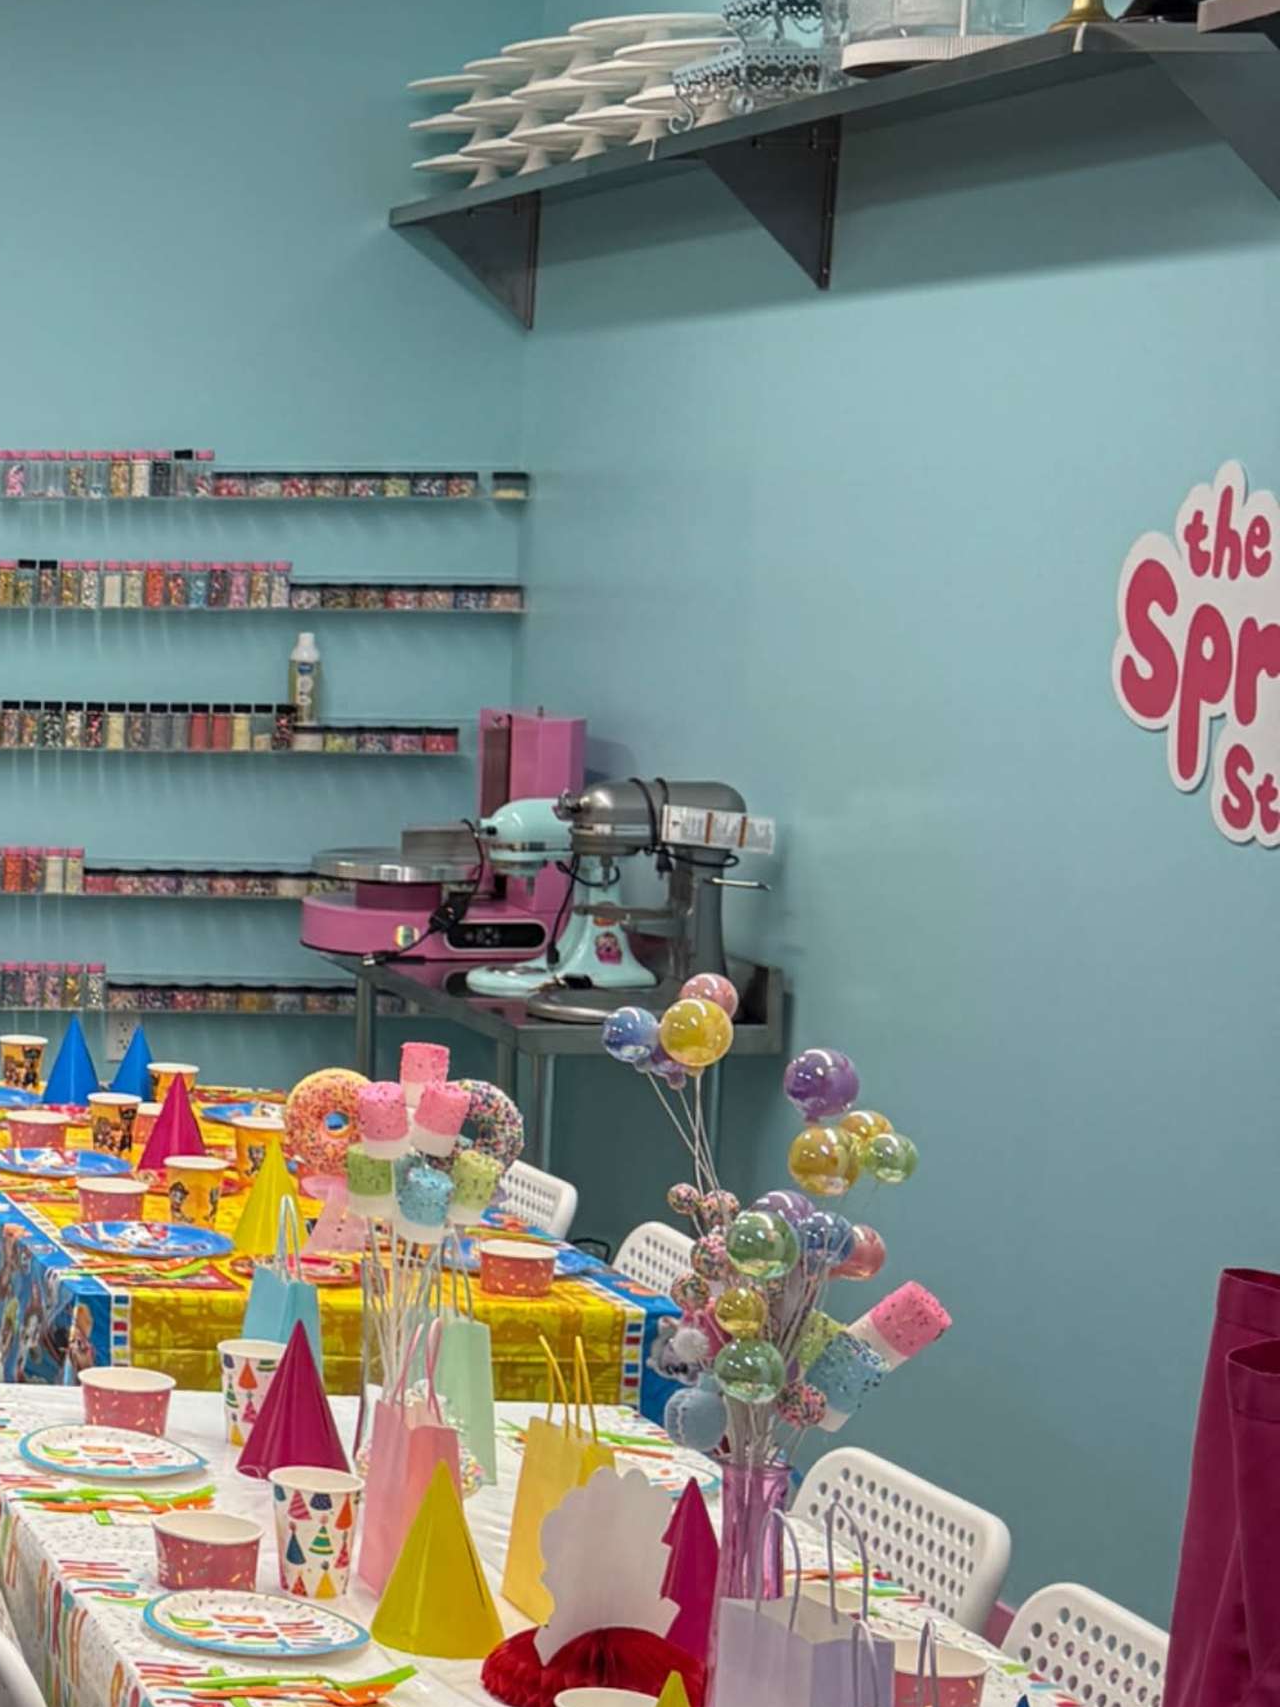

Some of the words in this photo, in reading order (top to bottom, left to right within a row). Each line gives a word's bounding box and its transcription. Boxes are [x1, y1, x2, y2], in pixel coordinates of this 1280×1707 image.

[1184, 484, 1272, 581] the
[1120, 558, 1280, 781] Spr
[1221, 743, 1280, 834] St
